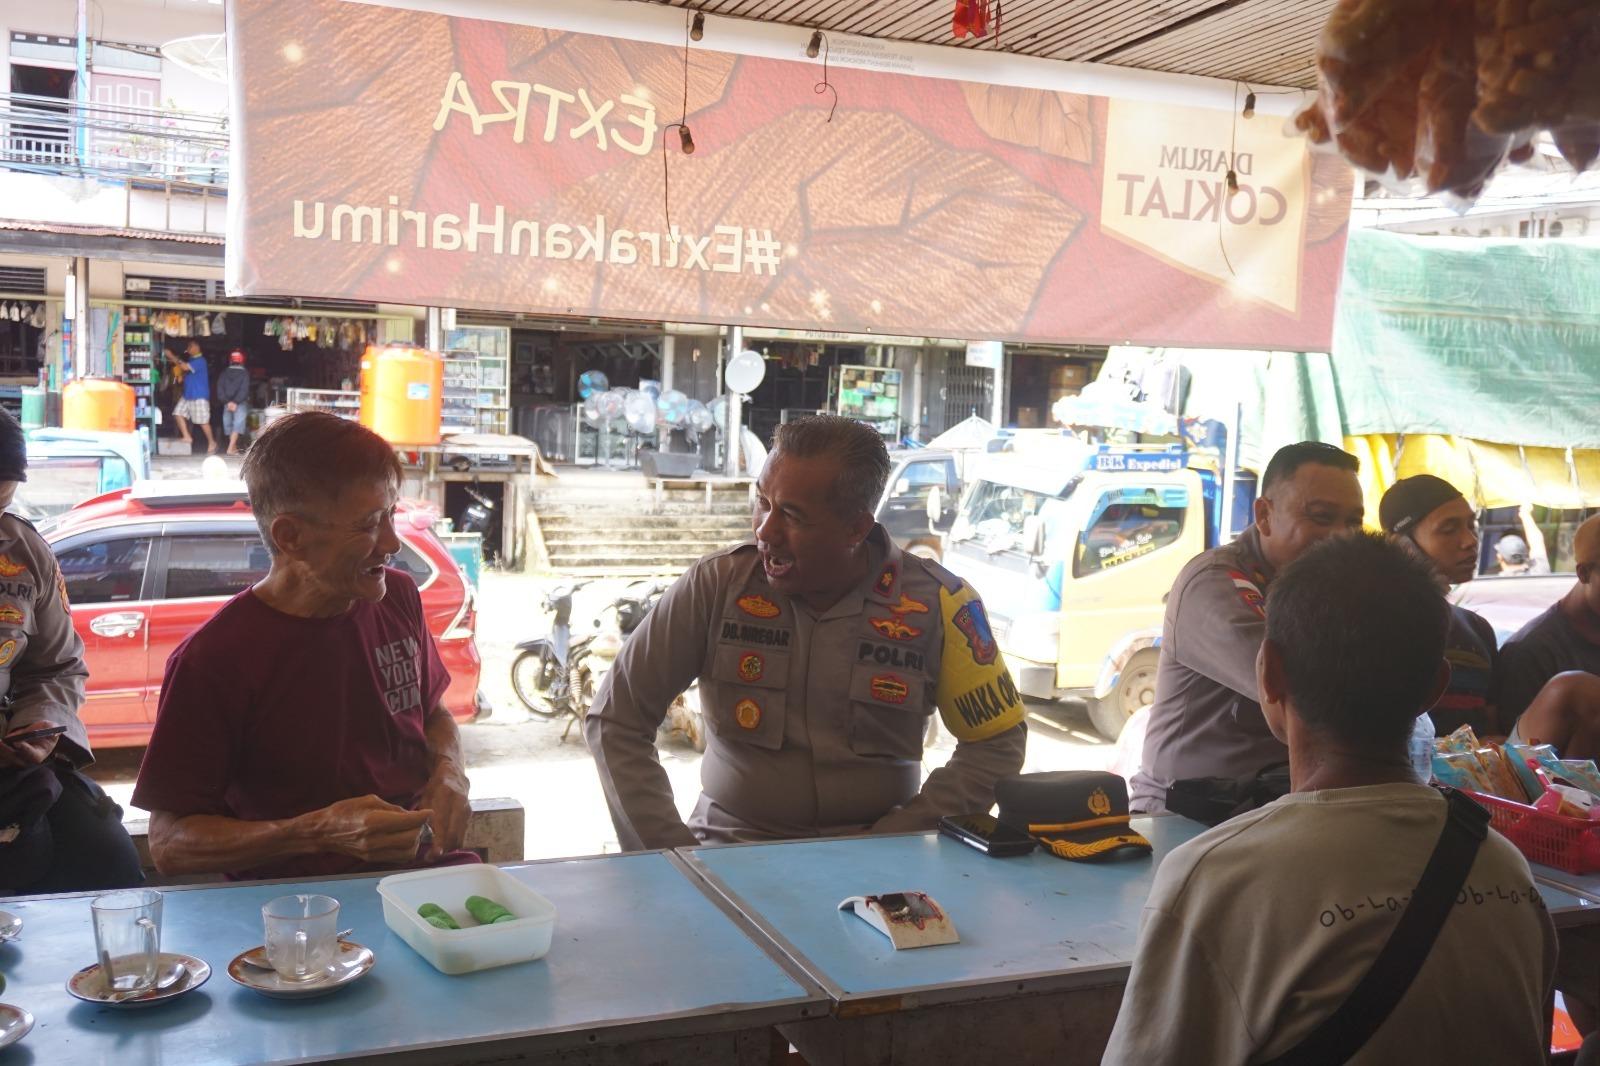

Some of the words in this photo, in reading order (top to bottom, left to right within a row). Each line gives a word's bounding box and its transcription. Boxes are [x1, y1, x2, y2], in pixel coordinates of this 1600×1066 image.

[1127, 457, 1182, 471] Expedisi
[375, 636, 418, 667] NEW
[858, 642, 924, 671] POLRI
[385, 686, 421, 714] CIT
[953, 682, 1006, 729] WAKA
[1319, 887, 1416, 928] Ob-La-
